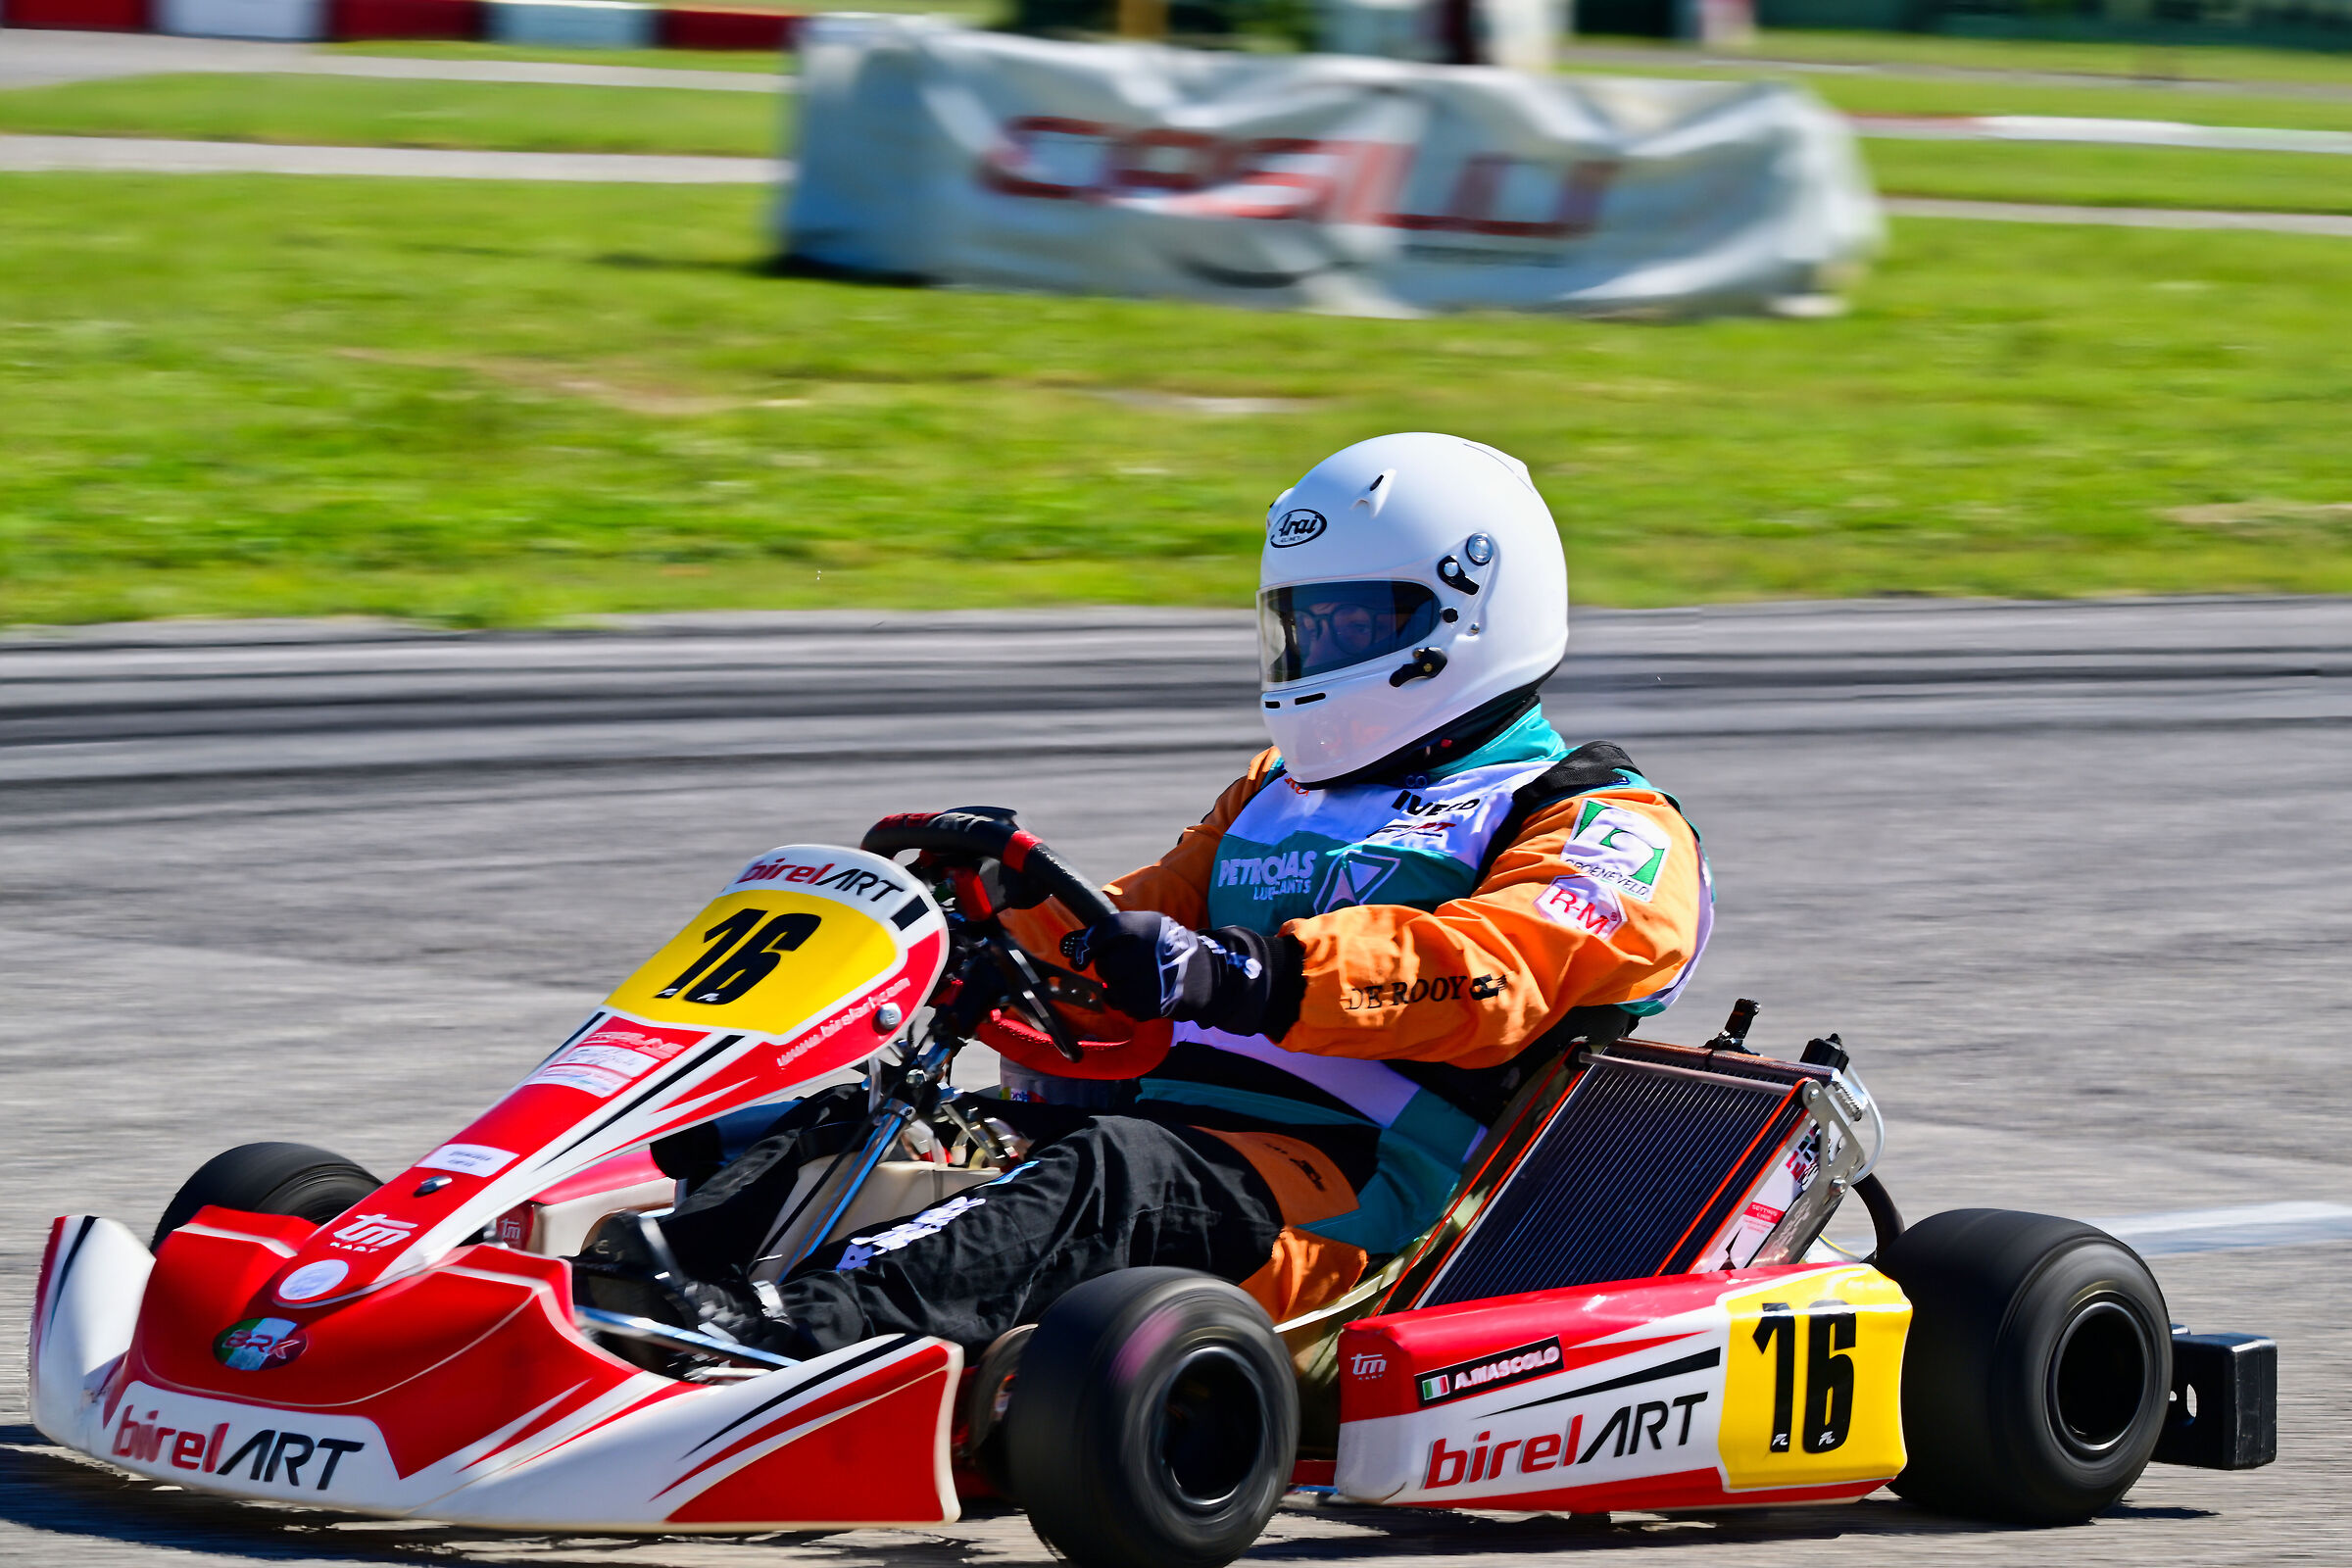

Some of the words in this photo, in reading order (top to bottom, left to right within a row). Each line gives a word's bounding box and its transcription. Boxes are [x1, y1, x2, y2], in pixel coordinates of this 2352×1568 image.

[1278, 513, 1319, 537] Arai
[735, 857, 906, 903] birelART
[653, 907, 822, 1005] 16
[1344, 985, 1384, 1010] DE
[1390, 975, 1468, 1006] ROOY
[1454, 1346, 1561, 1391] A.MASCOLO
[1751, 1299, 1857, 1454] 16
[111, 1403, 366, 1491] birelART
[1420, 1391, 1709, 1491] birelART
